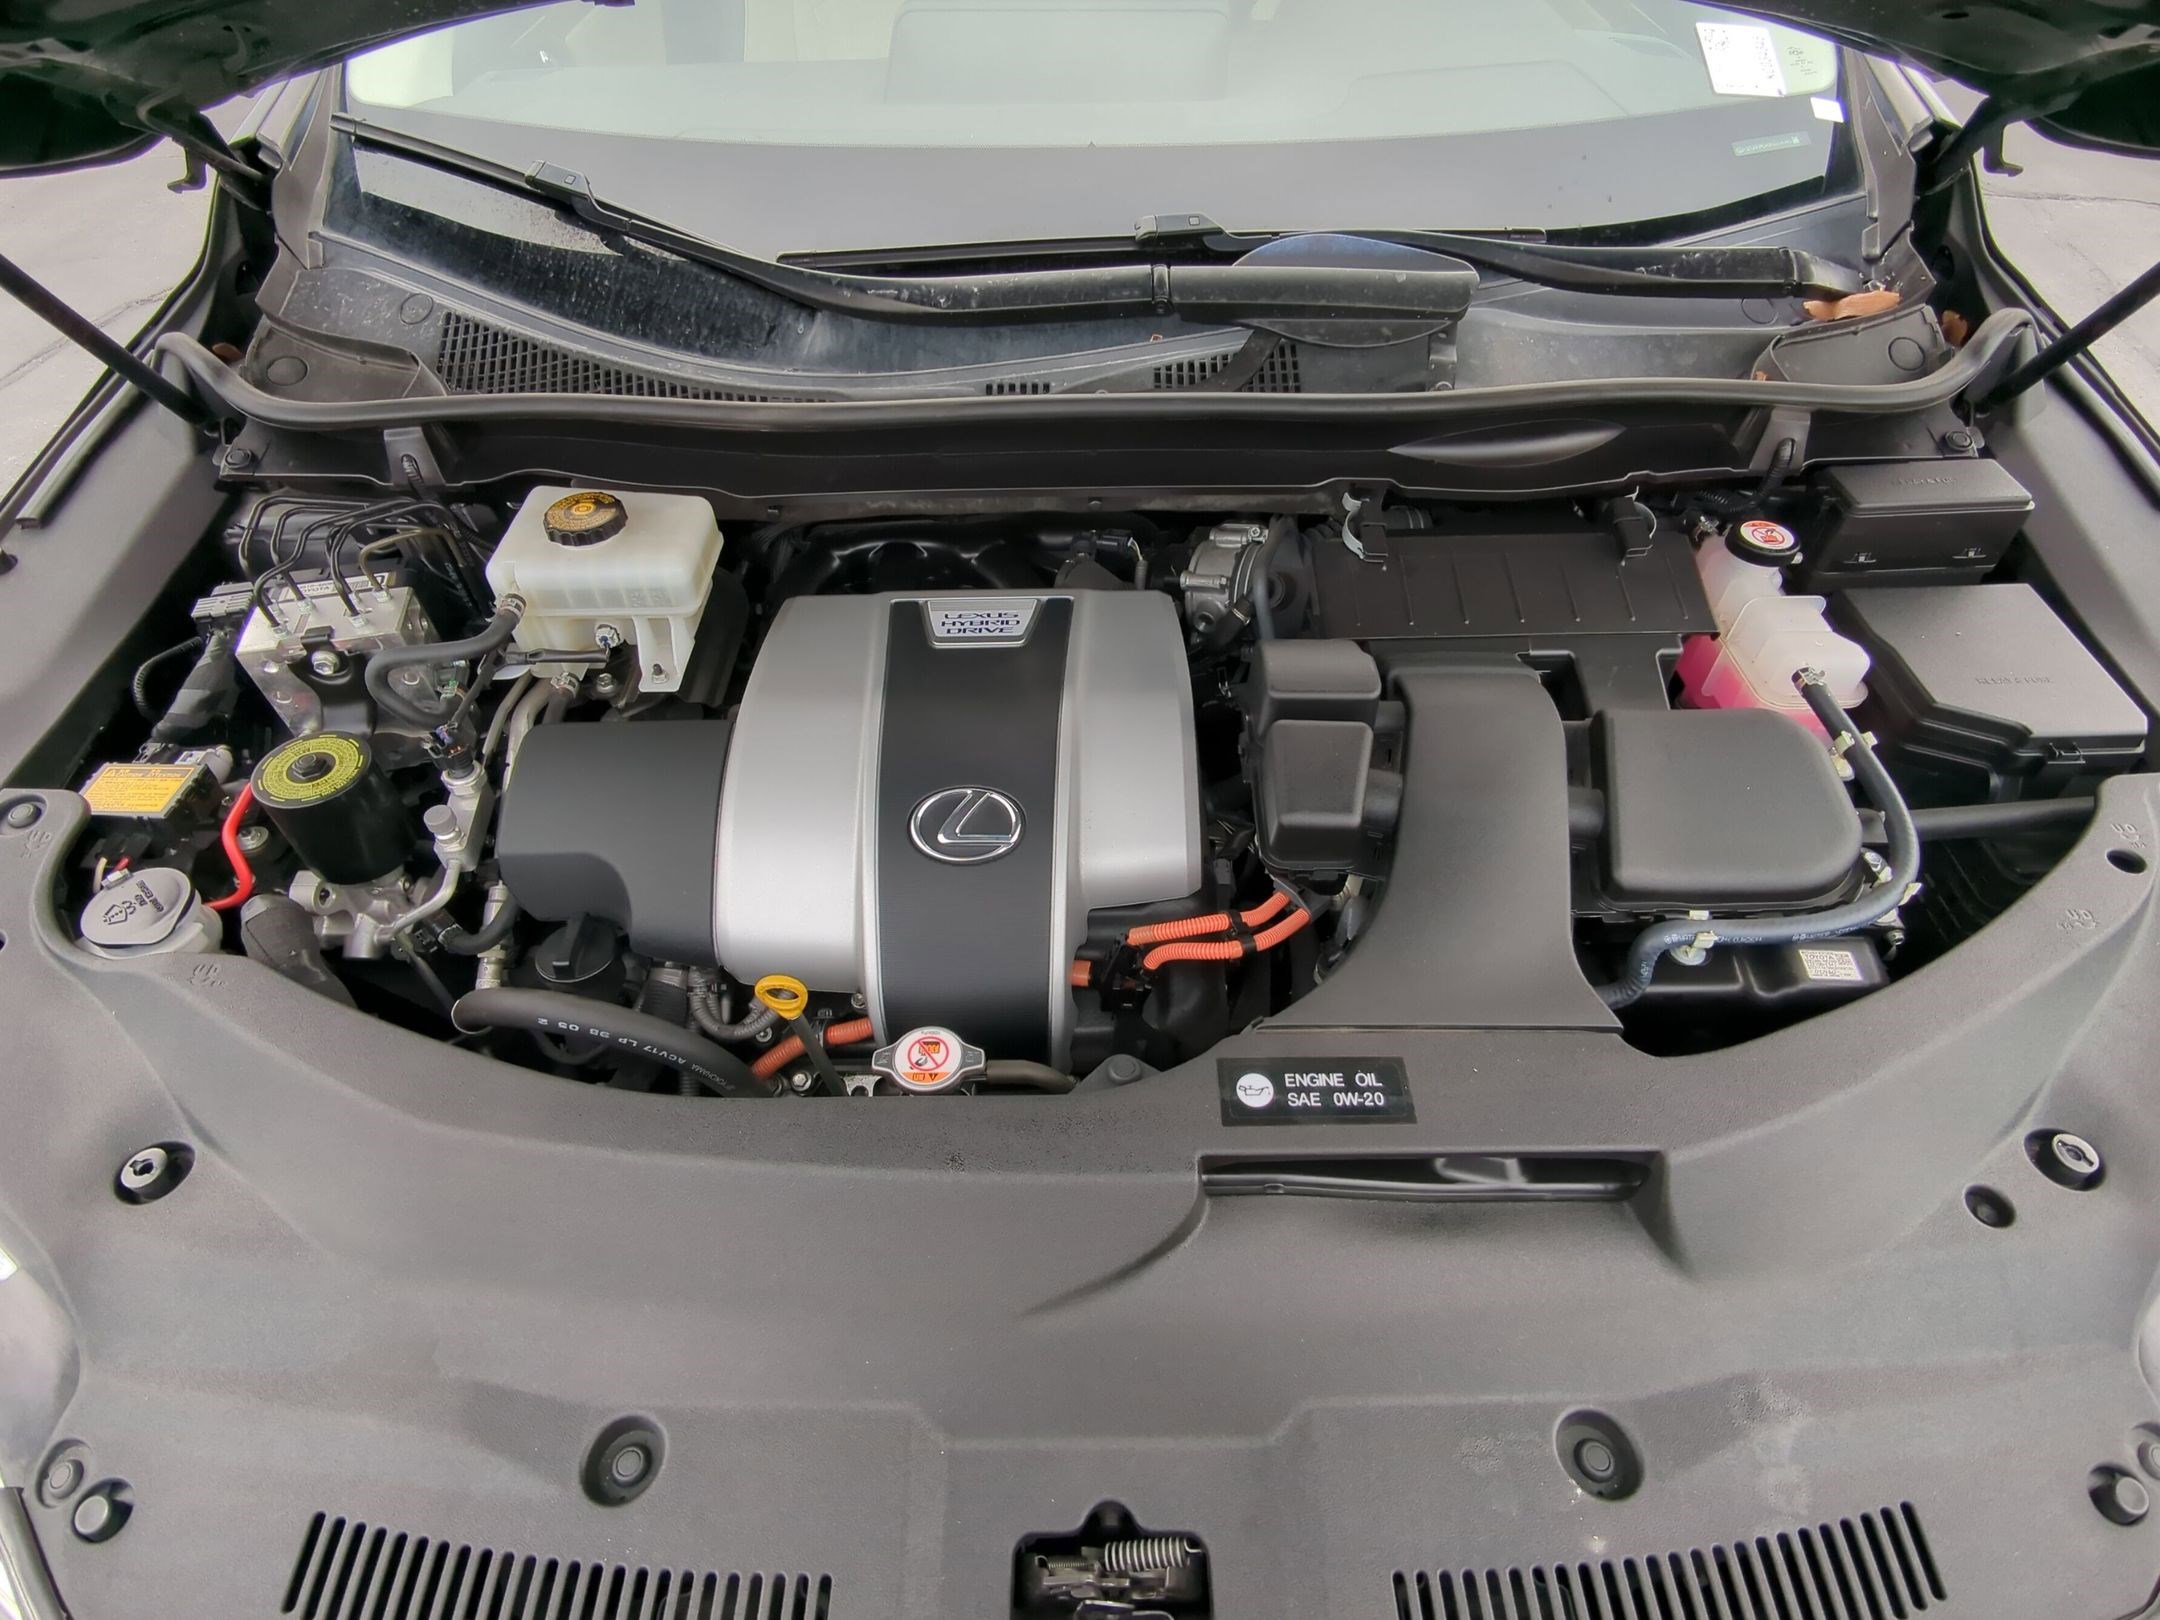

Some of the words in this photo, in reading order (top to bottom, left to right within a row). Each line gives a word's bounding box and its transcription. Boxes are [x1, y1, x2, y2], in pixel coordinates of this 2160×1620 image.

[618, 1037, 638, 1047] LP
[1284, 1073, 1345, 1087] ENGINE
[1354, 1073, 1383, 1087] OIL
[1287, 1093, 1322, 1106] SAE
[1333, 1092, 1384, 1106] 0W-20
